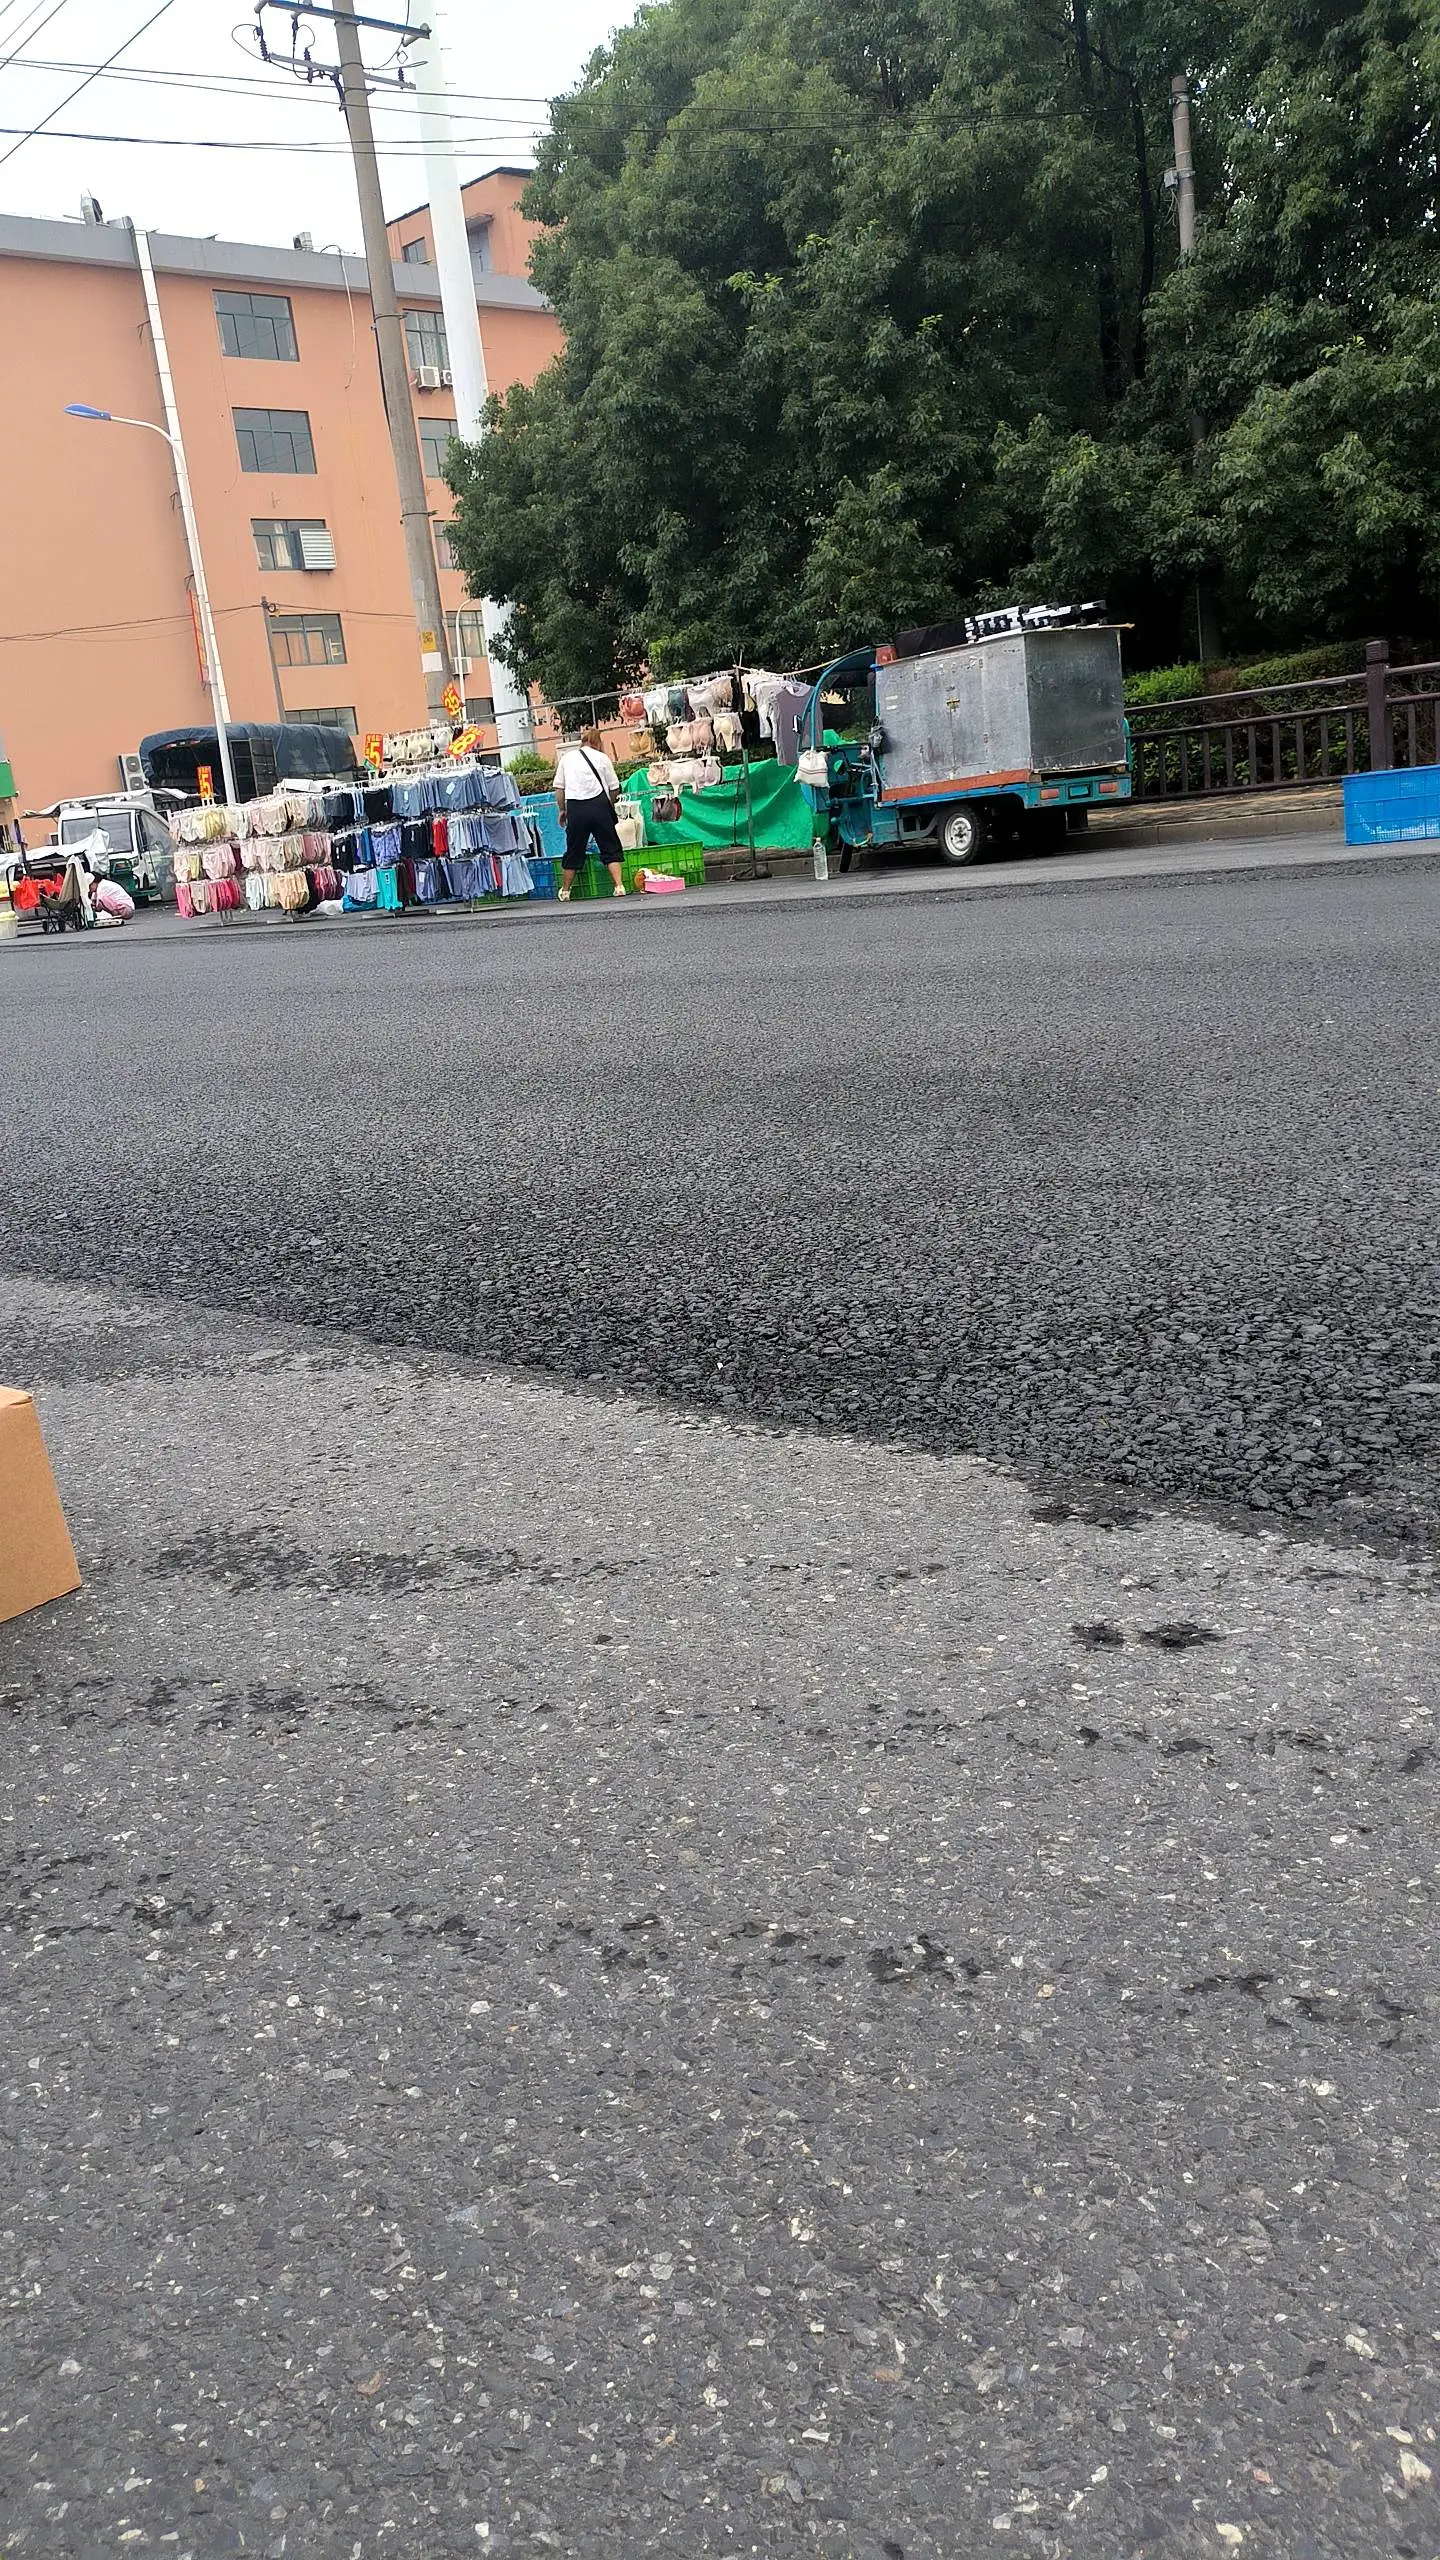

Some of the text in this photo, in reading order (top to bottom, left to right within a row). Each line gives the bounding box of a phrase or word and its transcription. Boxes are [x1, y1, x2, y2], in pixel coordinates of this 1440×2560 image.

[444, 688, 461, 716] 35
[369, 741, 381, 768] 5
[201, 773, 211, 799] 5
